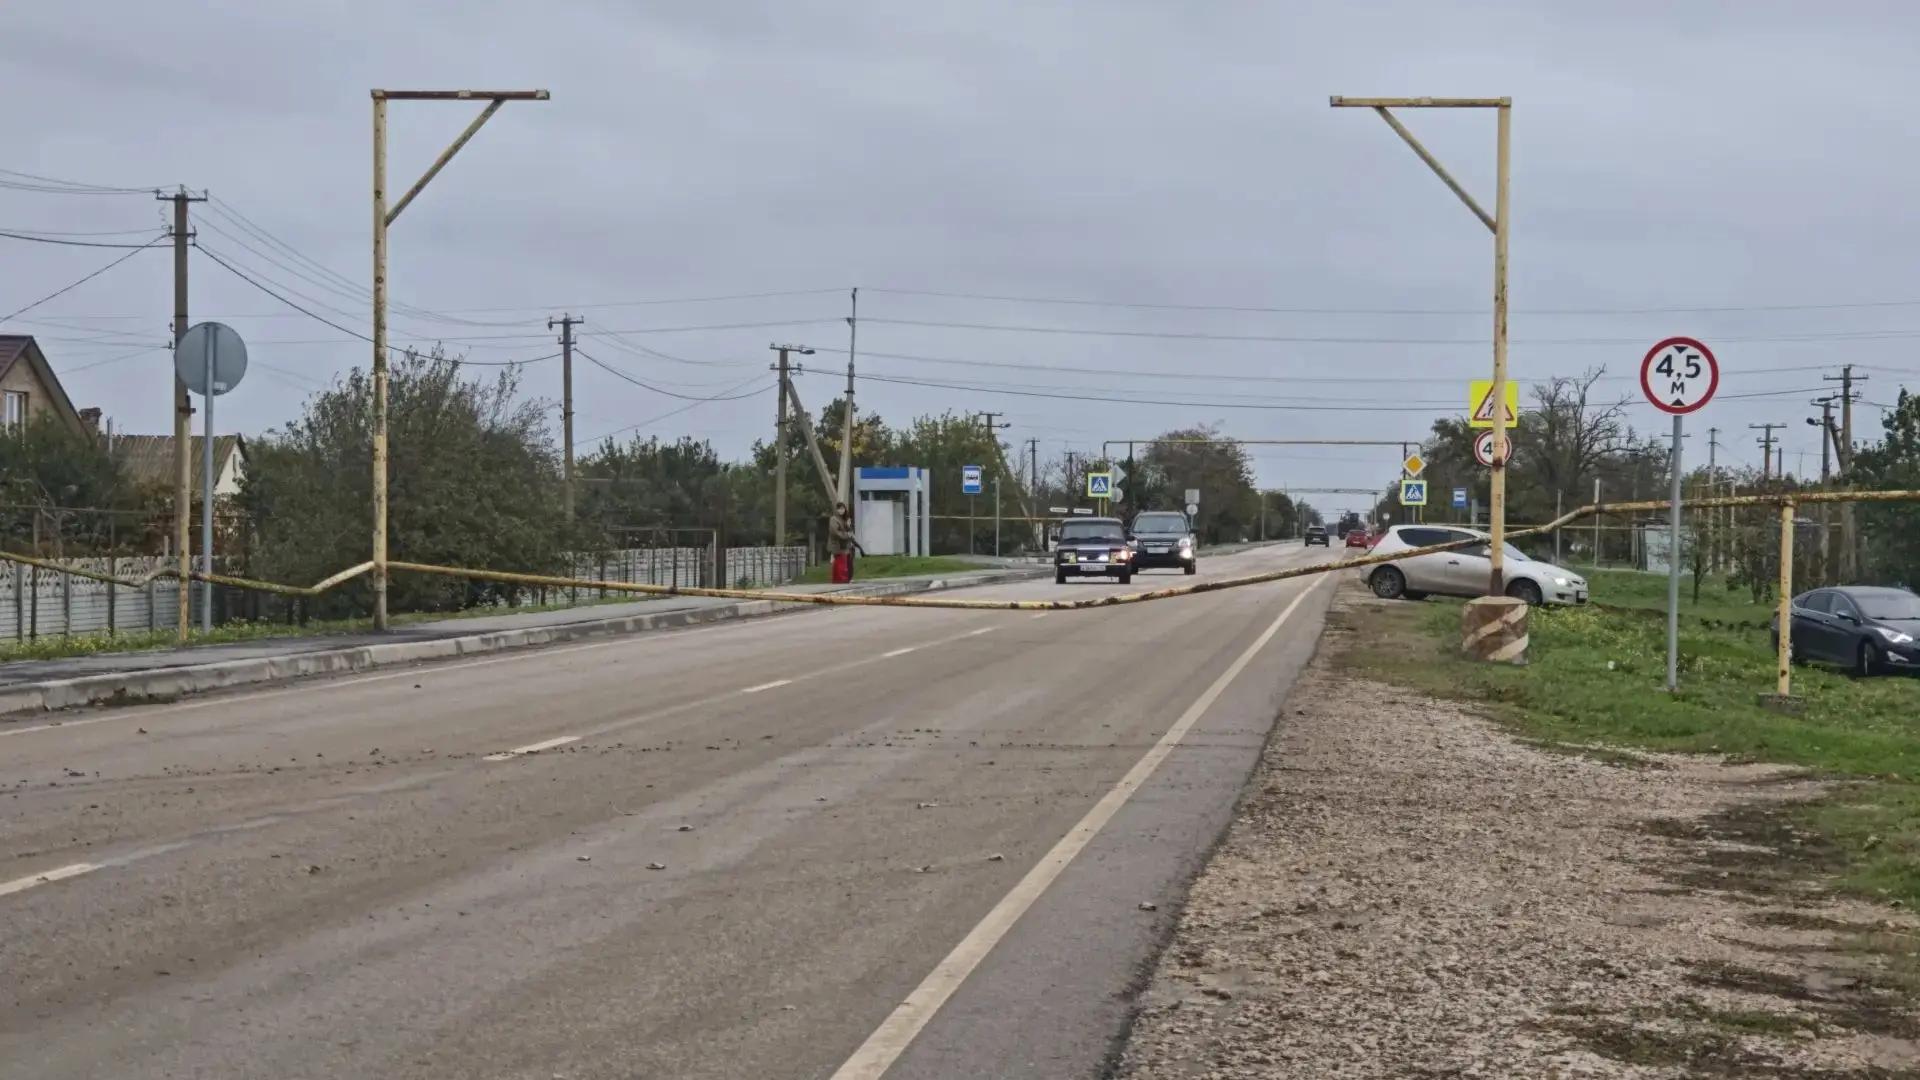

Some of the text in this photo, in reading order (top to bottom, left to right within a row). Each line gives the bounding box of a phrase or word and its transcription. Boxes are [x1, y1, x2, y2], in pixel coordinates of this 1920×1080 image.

[1655, 354, 1701, 380] 4,5
[1670, 381, 1684, 395] М
[1482, 441, 1493, 455] 4
